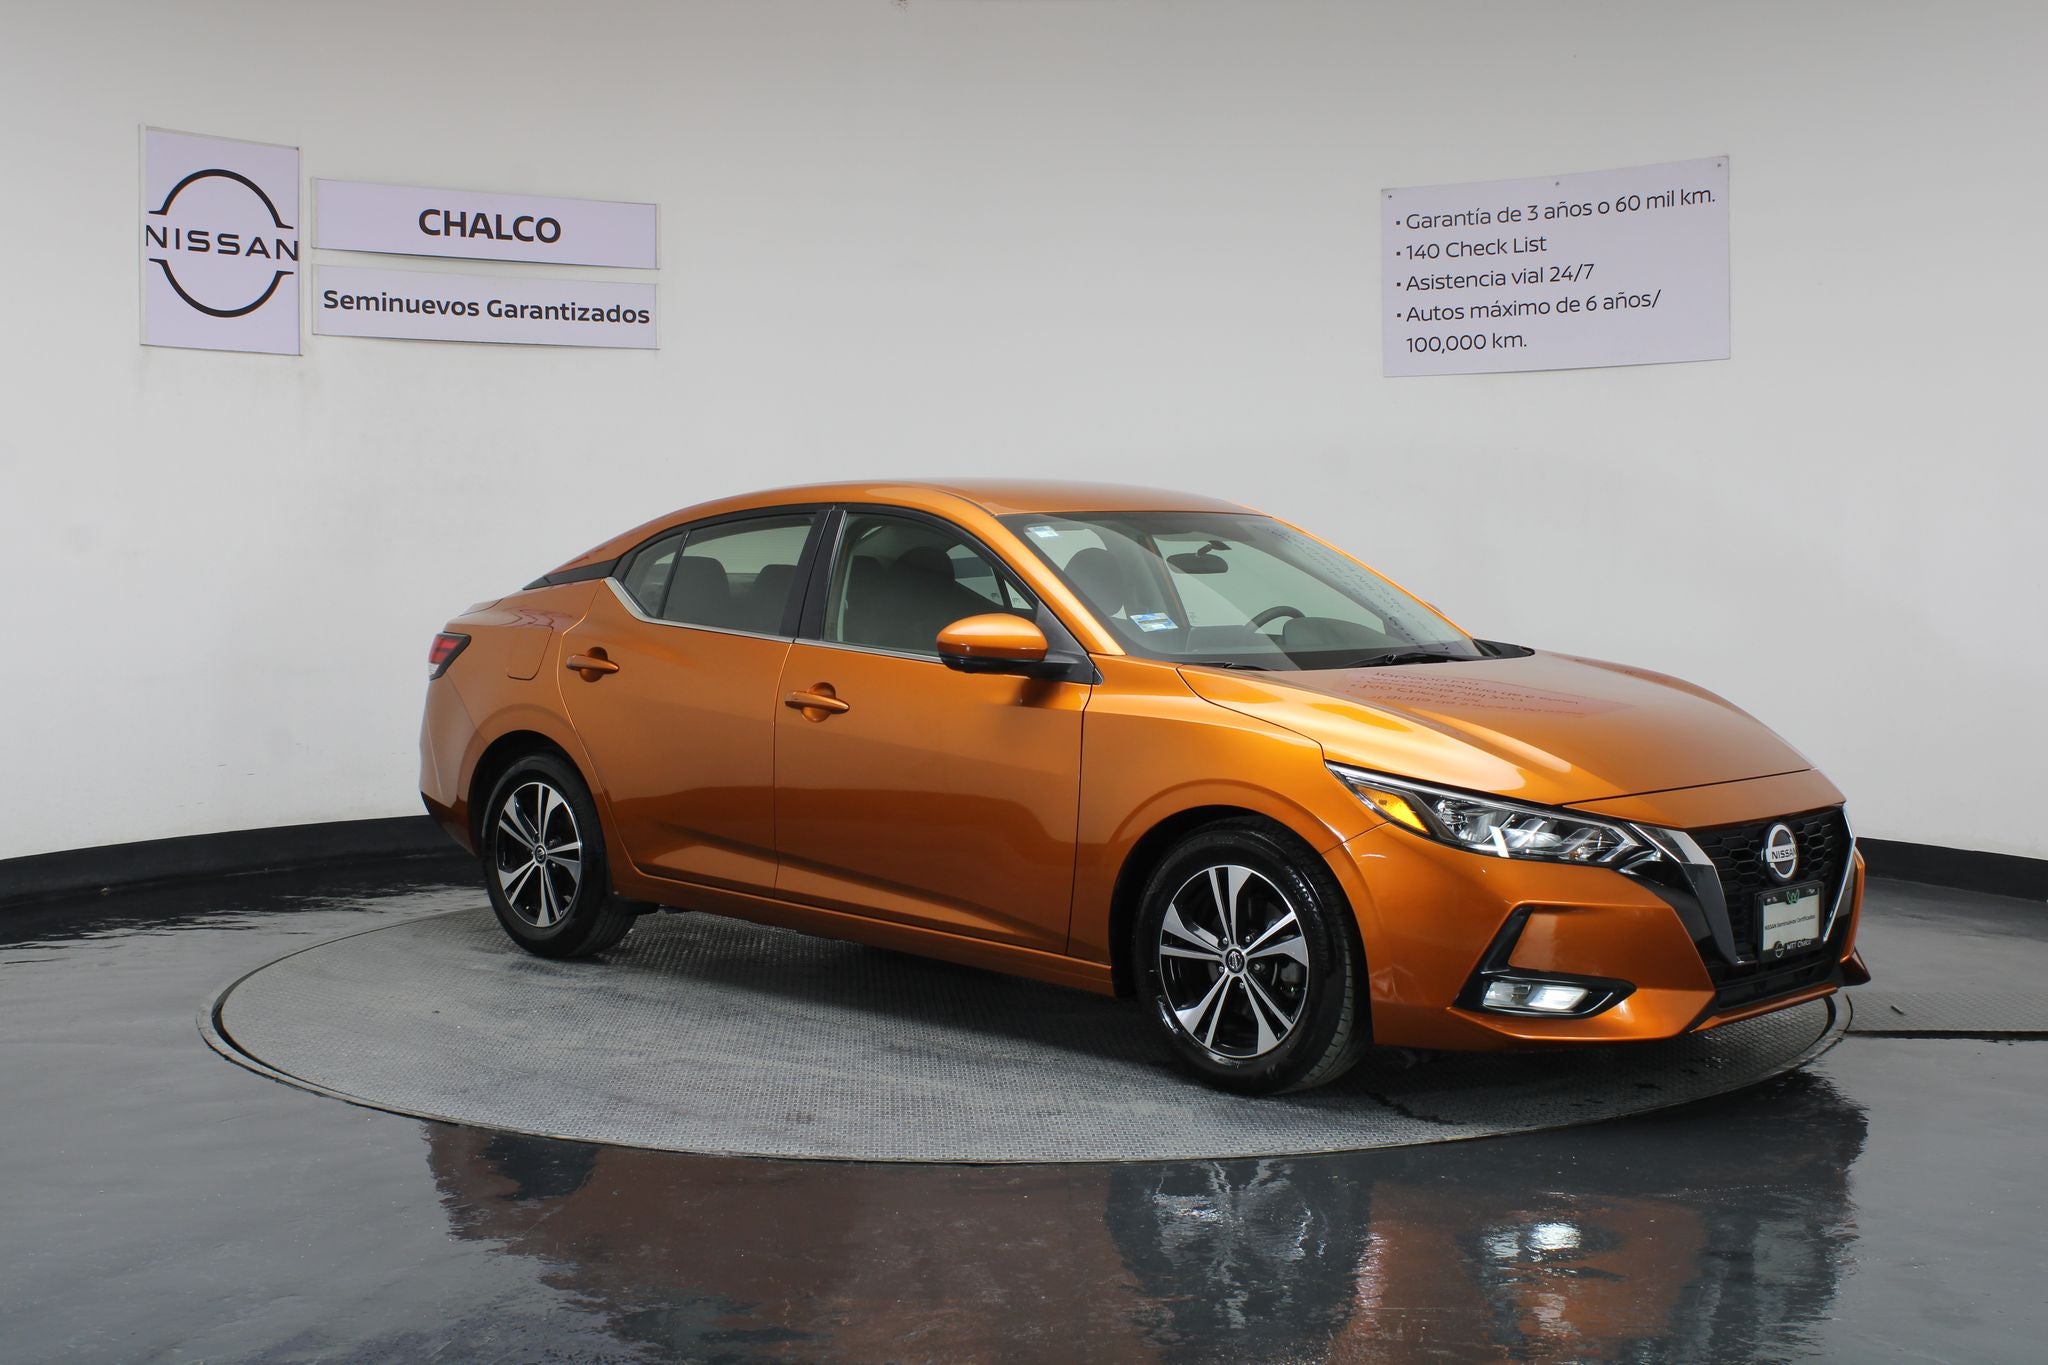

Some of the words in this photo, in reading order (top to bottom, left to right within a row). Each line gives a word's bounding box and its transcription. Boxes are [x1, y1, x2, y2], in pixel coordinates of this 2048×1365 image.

[418, 208, 562, 244] CHALCO
[1405, 206, 1492, 230] Garantía
[1496, 206, 1522, 224] de
[1527, 204, 1539, 222] 3
[1543, 200, 1593, 221] años
[1597, 200, 1611, 215] o
[1615, 194, 1641, 213] 60
[1646, 189, 1675, 210] mil
[1680, 188, 1716, 206] km.
[145, 224, 300, 263] NISSAN
[1405, 243, 1441, 261] 140
[1445, 237, 1509, 258] Check
[1513, 235, 1548, 254] List
[1405, 269, 1507, 292] Asistencia
[1510, 265, 1544, 285] vial
[1549, 263, 1595, 283] 24/7
[323, 289, 480, 318] Seminuevos
[486, 299, 651, 325] Garantizados
[1405, 305, 1465, 323] Autos
[1470, 299, 1551, 320] máximo
[1555, 296, 1581, 314] de
[1585, 294, 1598, 312] 6
[1602, 289, 1662, 311] años/
[1405, 333, 1487, 355] 100,000
[1492, 332, 1528, 349] km.
